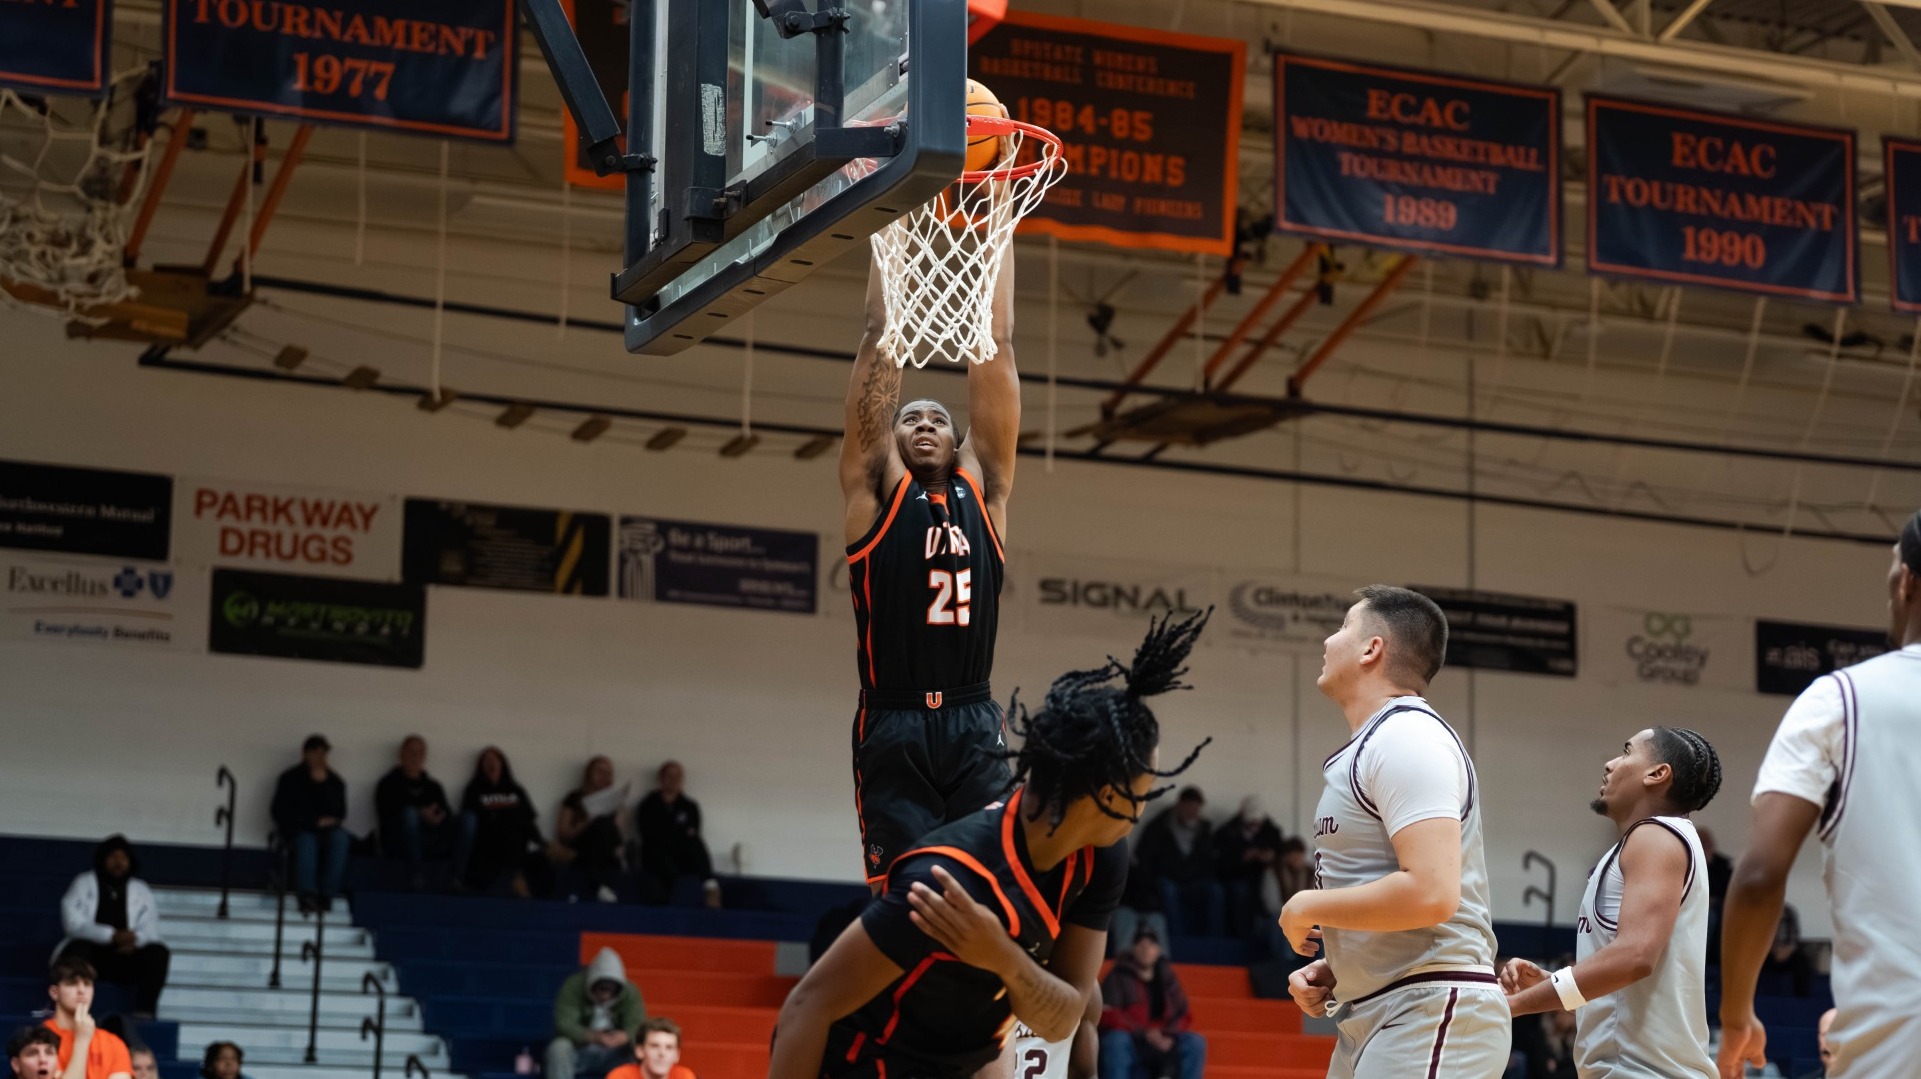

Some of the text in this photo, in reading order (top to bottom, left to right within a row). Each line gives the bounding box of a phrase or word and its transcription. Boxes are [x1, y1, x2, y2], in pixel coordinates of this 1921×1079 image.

[192, 0, 495, 60] TOURNAMENT
[290, 52, 396, 102] 1977
[1017, 96, 1154, 142] 1984-85
[1366, 88, 1470, 132] ECAC
[1338, 151, 1500, 195] TOURNAMENT
[1400, 131, 1545, 171] BASKETBALL
[1670, 130, 1777, 180] ECAC
[1382, 192, 1458, 231] 1989
[1601, 172, 1842, 232] TOURNAMENT
[1682, 225, 1767, 270] 1990
[194, 488, 381, 533] PARKWAY
[219, 526, 354, 565] DRUGS
[8, 565, 110, 597] Excellus
[926, 567, 972, 627] 25
[1038, 577, 1199, 614] SIGNAL
[925, 690, 943, 710] U
